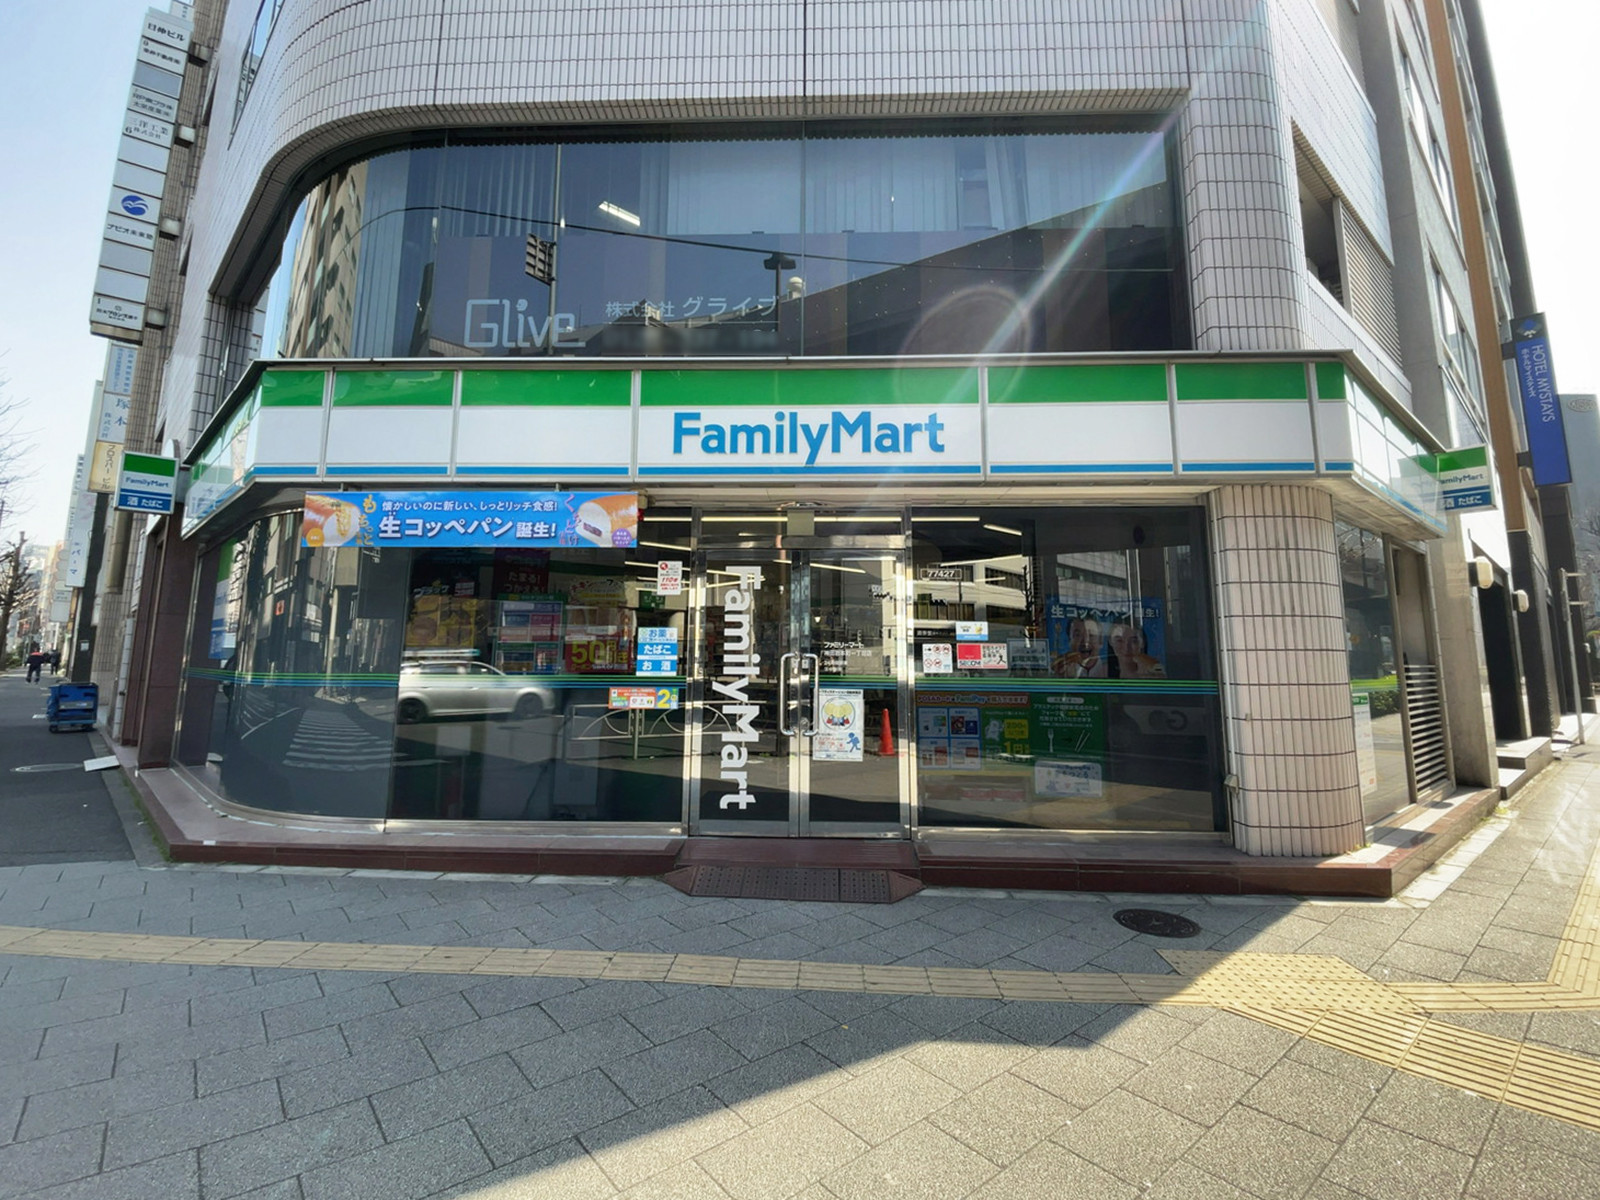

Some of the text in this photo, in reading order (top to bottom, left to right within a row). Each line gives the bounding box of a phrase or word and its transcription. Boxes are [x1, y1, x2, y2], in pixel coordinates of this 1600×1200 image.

[605, 301, 675, 319] 株式会社
[1531, 344, 1556, 423] HOTEL MYSTAYS
[673, 411, 945, 466] FamilyMart
[125, 477, 169, 487] FamilyMart
[1441, 473, 1484, 484] amilyMart
[141, 499, 163, 508] たばこ
[1458, 495, 1483, 506] たばこ
[643, 644, 672, 655] たばこ
[824, 641, 865, 649] ファミリーマート
[711, 565, 762, 810] FamilyMart
